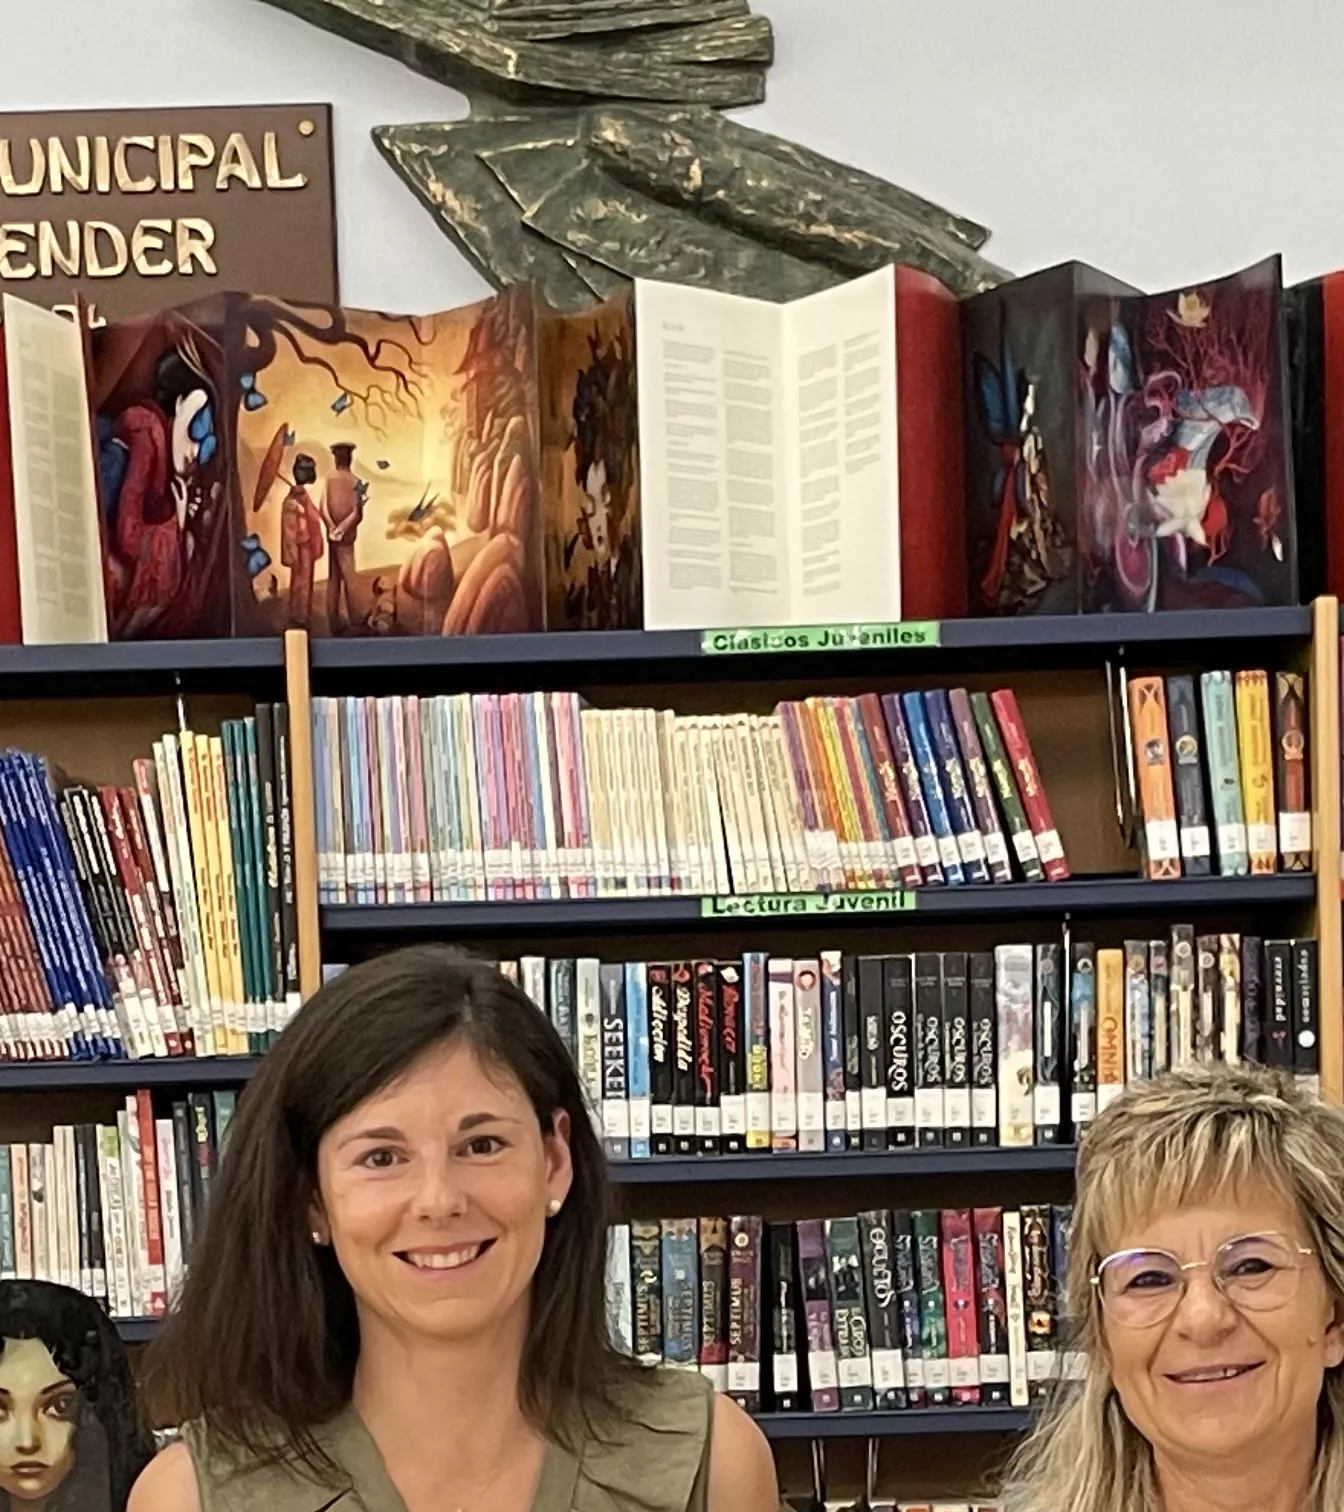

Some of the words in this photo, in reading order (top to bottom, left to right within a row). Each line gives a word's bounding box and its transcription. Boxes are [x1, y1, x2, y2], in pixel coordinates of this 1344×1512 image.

[817, 628, 926, 648] Juveniles
[712, 896, 806, 914] Lectura
[816, 891, 906, 911] Juvenil
[889, 1010, 909, 1092] OSCUROS
[925, 1016, 941, 1083] OSCUROS
[952, 1016, 967, 1083] OSCUROS
[978, 1017, 993, 1085] OSCUROS
[869, 1227, 897, 1309] OCULTOS
